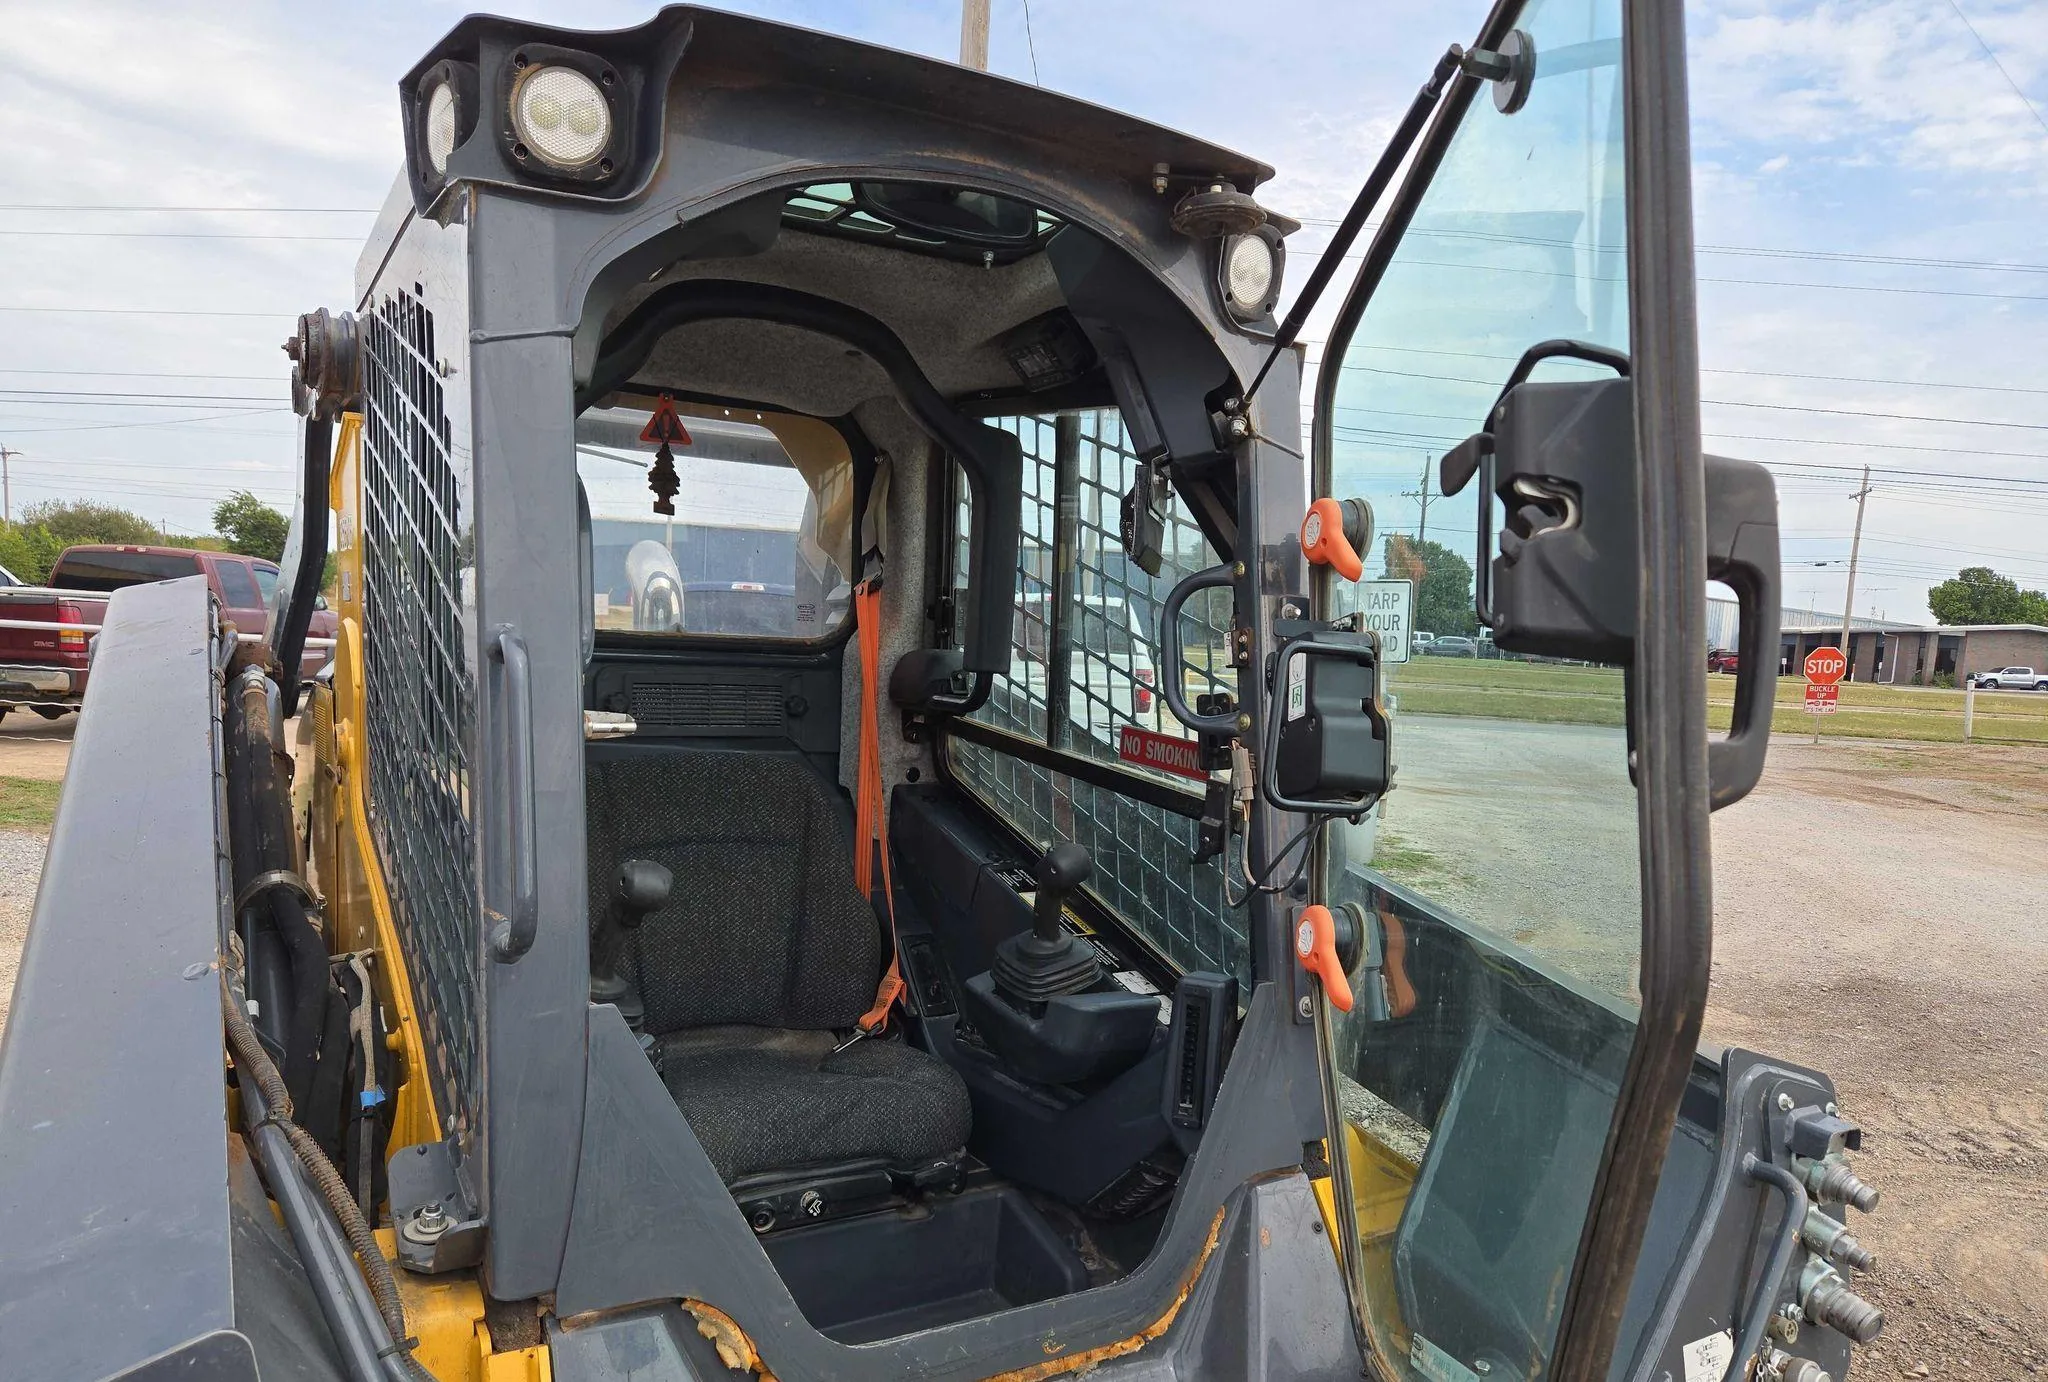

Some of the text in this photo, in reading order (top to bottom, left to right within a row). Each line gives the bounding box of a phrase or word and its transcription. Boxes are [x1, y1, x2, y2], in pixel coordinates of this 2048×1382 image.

[1367, 592, 1400, 610] TARP
[1365, 614, 1400, 631] YOUR
[33, 640, 55, 648] GMC
[1381, 635, 1398, 652] AD
[1807, 660, 1844, 674] STOP
[1809, 685, 1835, 693] BUCKLE
[1123, 735, 1203, 773] NO SMOKIN
